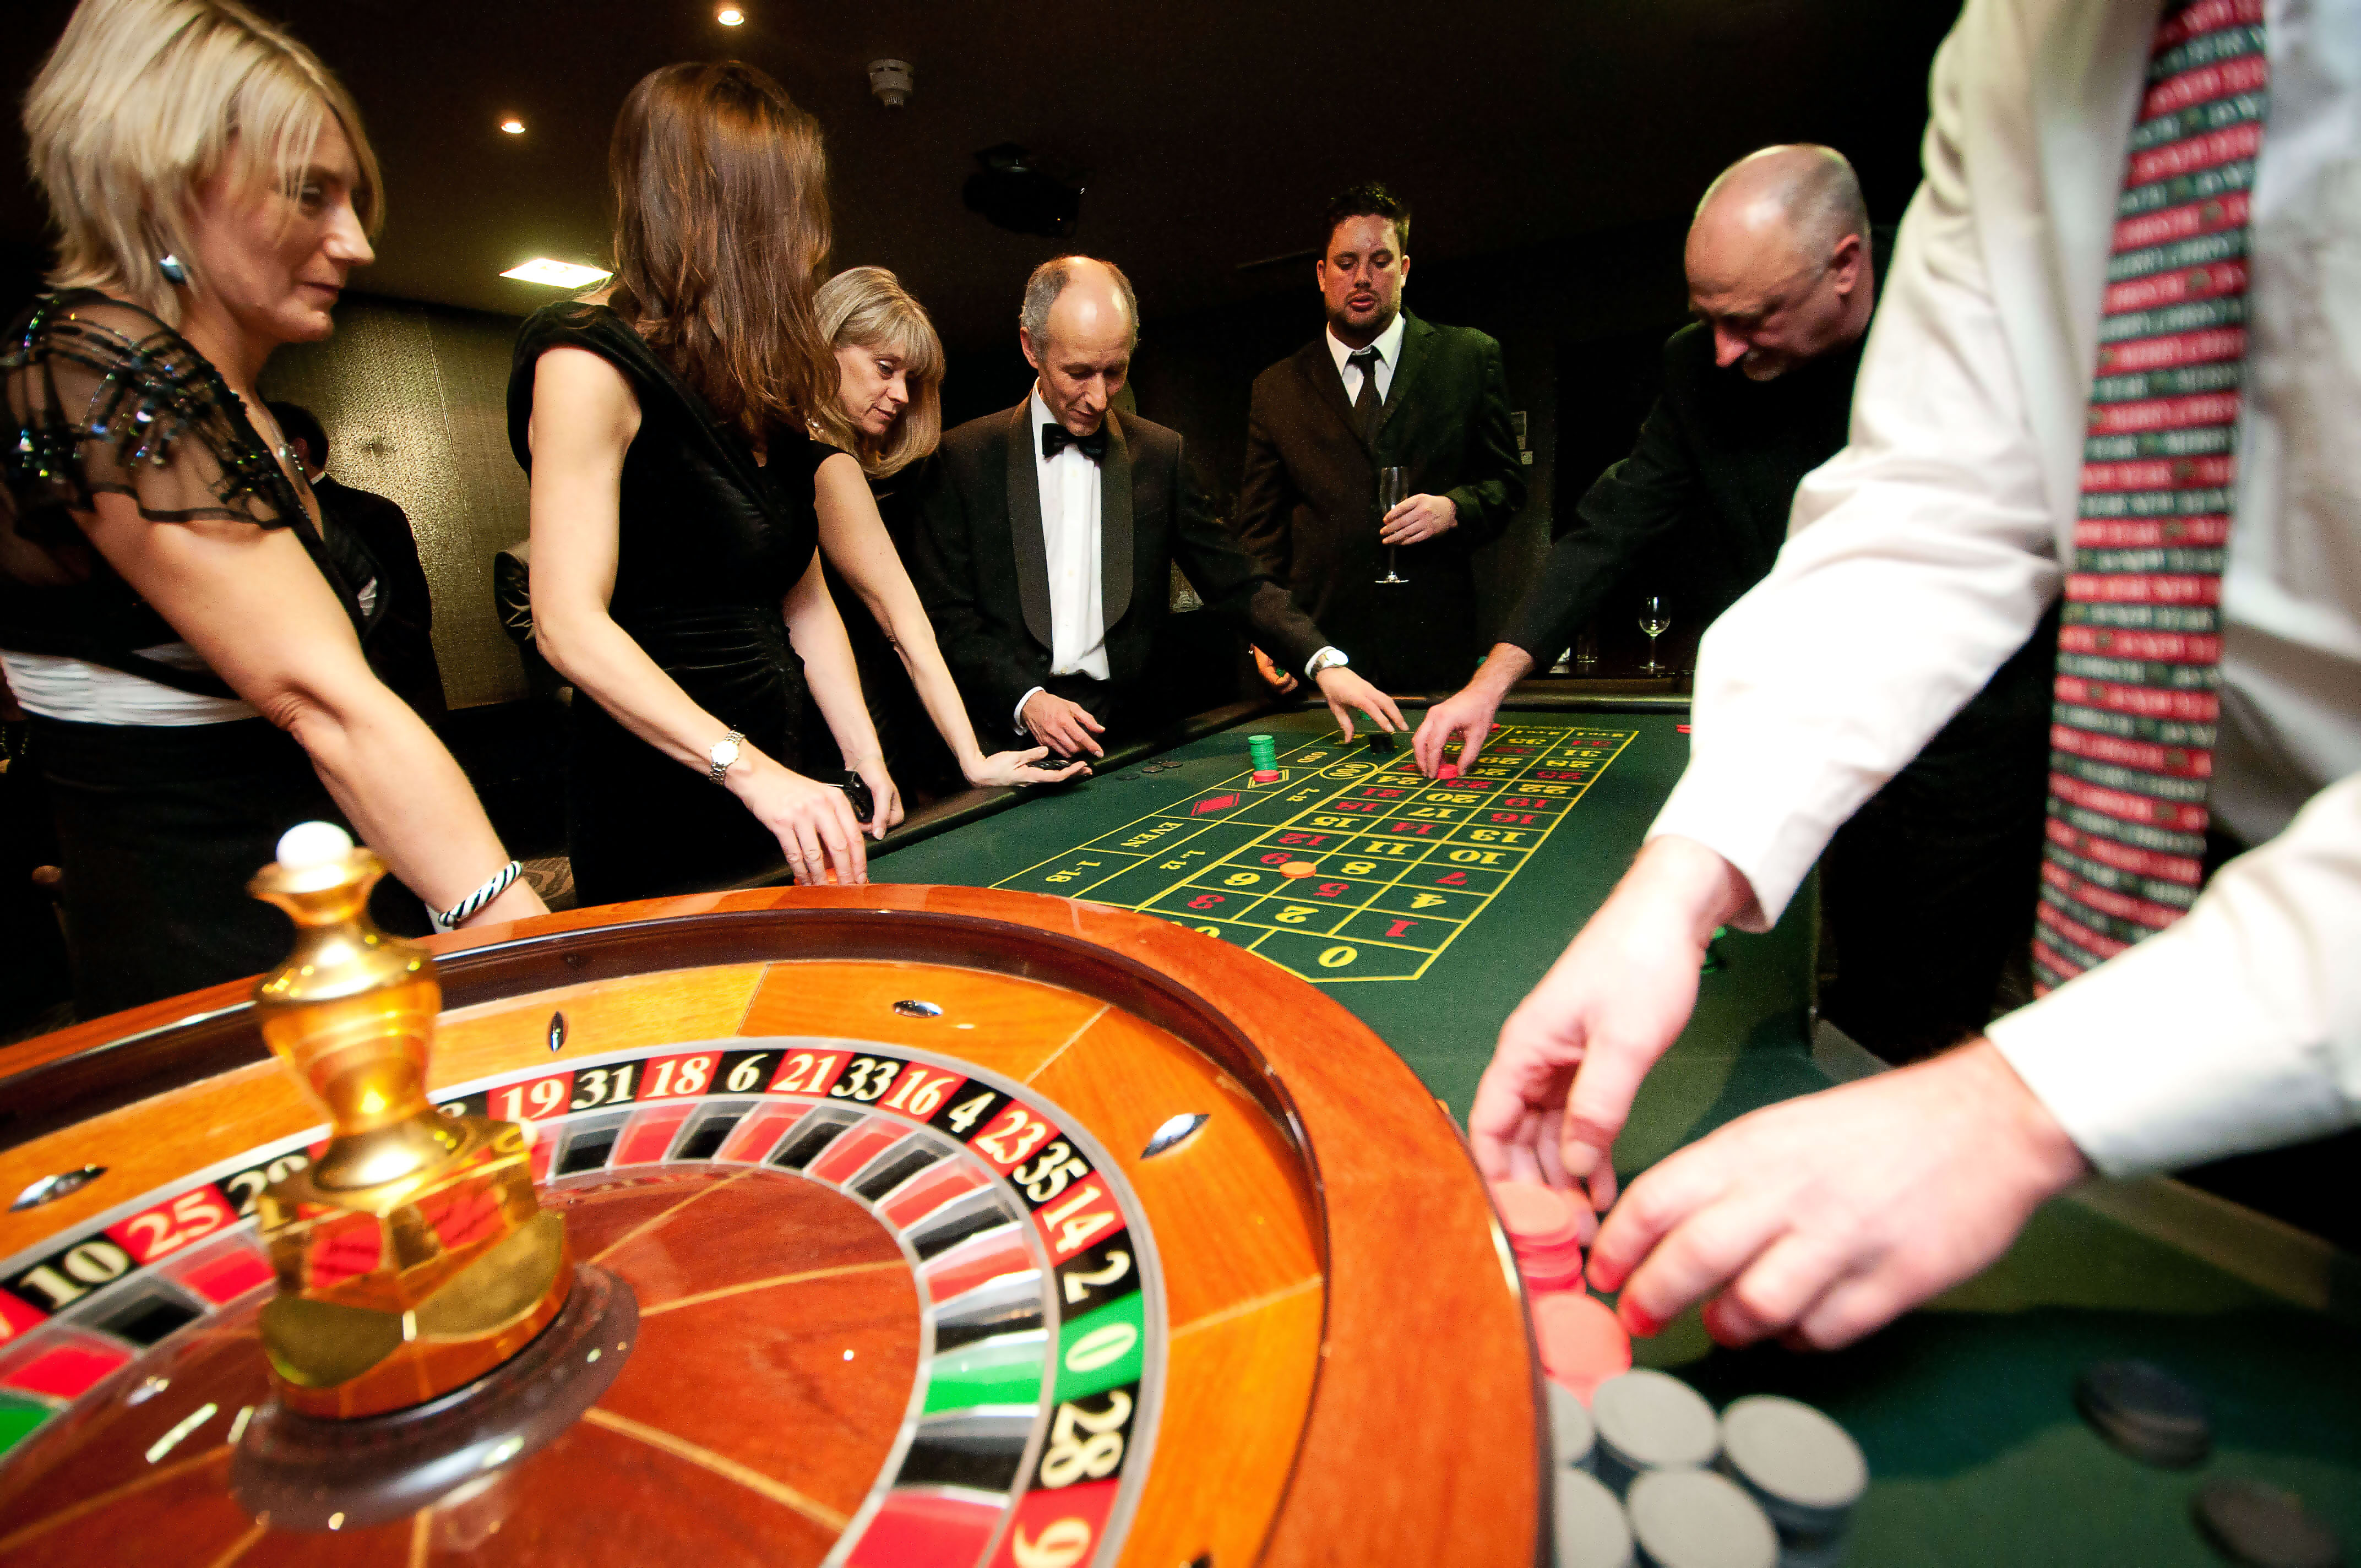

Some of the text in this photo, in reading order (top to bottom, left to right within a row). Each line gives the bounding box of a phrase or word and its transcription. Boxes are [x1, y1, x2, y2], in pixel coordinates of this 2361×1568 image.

[1546, 760, 1595, 768] 28
[1377, 775, 1423, 785] 24
[1362, 788, 1406, 798] 21
[1519, 783, 1572, 794] 22
[1426, 793, 1481, 803] 20
[1505, 798, 1551, 808] 19
[1335, 801, 1383, 812] 18
[1408, 808, 1458, 818] 17
[1309, 816, 1360, 827] 15
[1491, 813, 1540, 825] 16
[1120, 822, 1184, 847] EVEN
[1391, 822, 1439, 835] 14
[1471, 829, 1526, 842] 13
[1278, 833, 1330, 846] 12
[1364, 841, 1415, 855] 11
[1260, 853, 1292, 864] 9
[1449, 850, 1506, 864] 10
[1046, 861, 1101, 883] 1-18
[1159, 860, 1187, 870] 12
[1341, 862, 1376, 874] 8
[1225, 872, 1260, 886] 6
[1435, 872, 1467, 886] 7
[1314, 883, 1350, 898] 5
[1188, 895, 1225, 908] 3
[1411, 893, 1446, 908] 4
[1275, 906, 1319, 923] 2
[1385, 919, 1419, 937] 1
[1318, 946, 1358, 967] 0
[644, 1056, 710, 1097] 18
[727, 1053, 769, 1092] 6
[772, 1053, 838, 1093] 21
[831, 1057, 900, 1101] 33
[570, 1064, 634, 1110] 31
[884, 1069, 956, 1116] 16
[501, 1079, 564, 1120] 19
[949, 1091, 996, 1134] 4
[975, 1109, 1046, 1164] 23
[1012, 1141, 1089, 1203] 35
[127, 1191, 223, 1260] 25
[1042, 1182, 1116, 1254] 14
[18, 1241, 130, 1309] 10
[1064, 1250, 1130, 1304] 2
[1065, 1322, 1138, 1372] 0
[1040, 1390, 1133, 1489] 28
